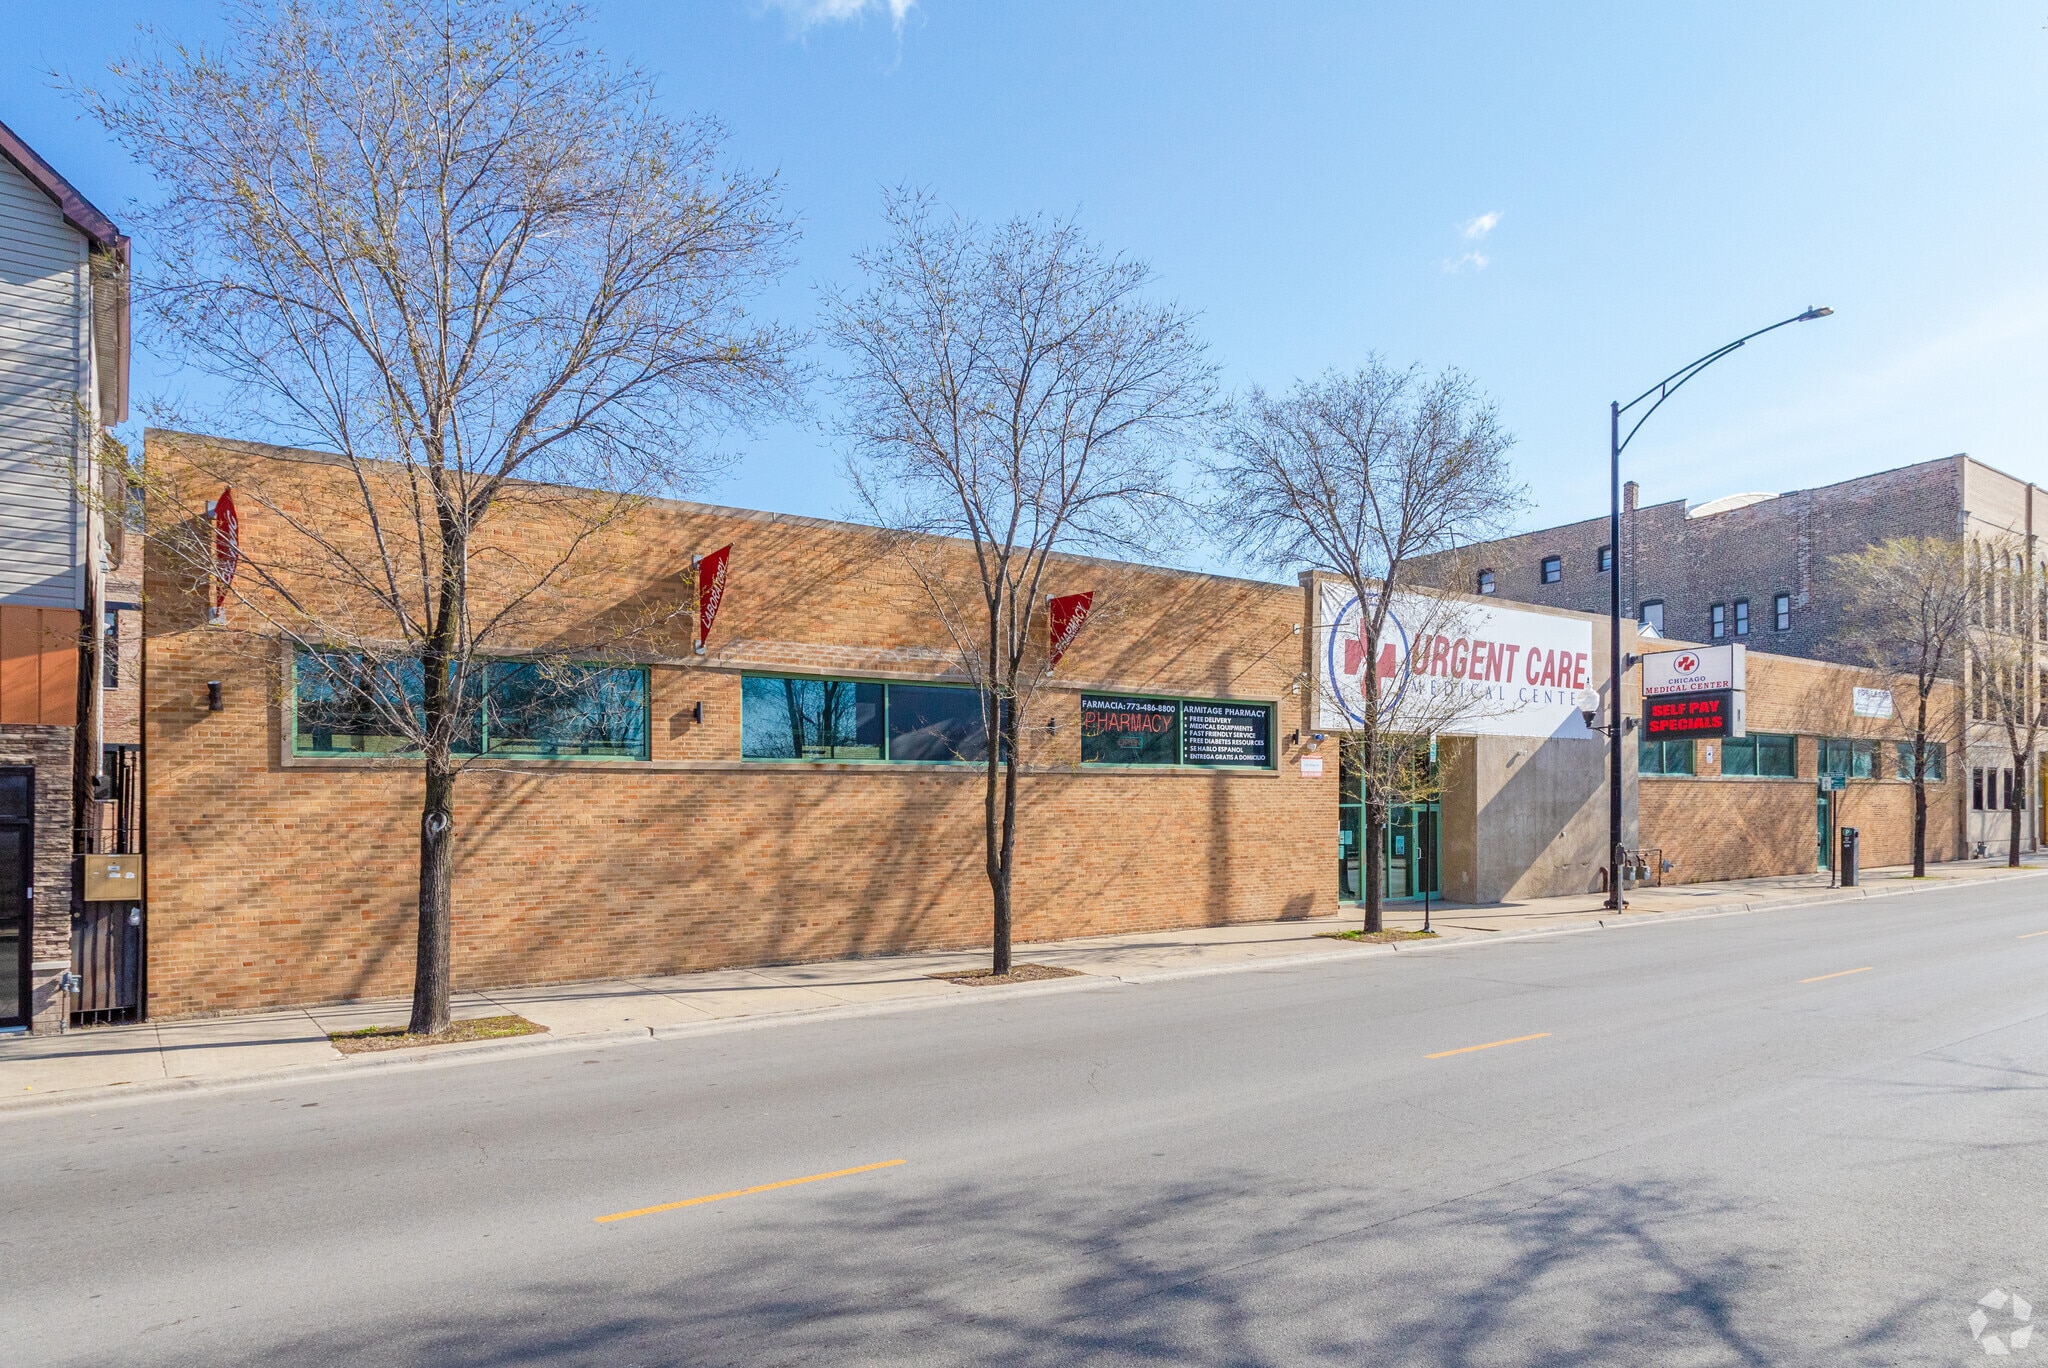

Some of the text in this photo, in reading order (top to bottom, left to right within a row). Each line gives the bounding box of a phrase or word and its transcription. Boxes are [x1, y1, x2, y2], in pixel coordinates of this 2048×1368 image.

[701, 556, 728, 629] LABORATORY
[1055, 601, 1087, 655] PHARMACY
[1411, 633, 1588, 690] URGENT CARE
[1645, 680, 1729, 695] MEDICAL CENTER
[1668, 675, 1706, 685] CHICAGO
[1519, 687, 1579, 706] CENTE
[1126, 702, 1176, 713] 773-486-8800
[1183, 705, 1266, 718] ARMITAGE PHARMACY
[1652, 700, 1720, 717] SELF PAY
[1084, 711, 1173, 733] PHARMACY
[1204, 716, 1232, 724] DELIVERY
[1649, 716, 1723, 733] SPECIALS
